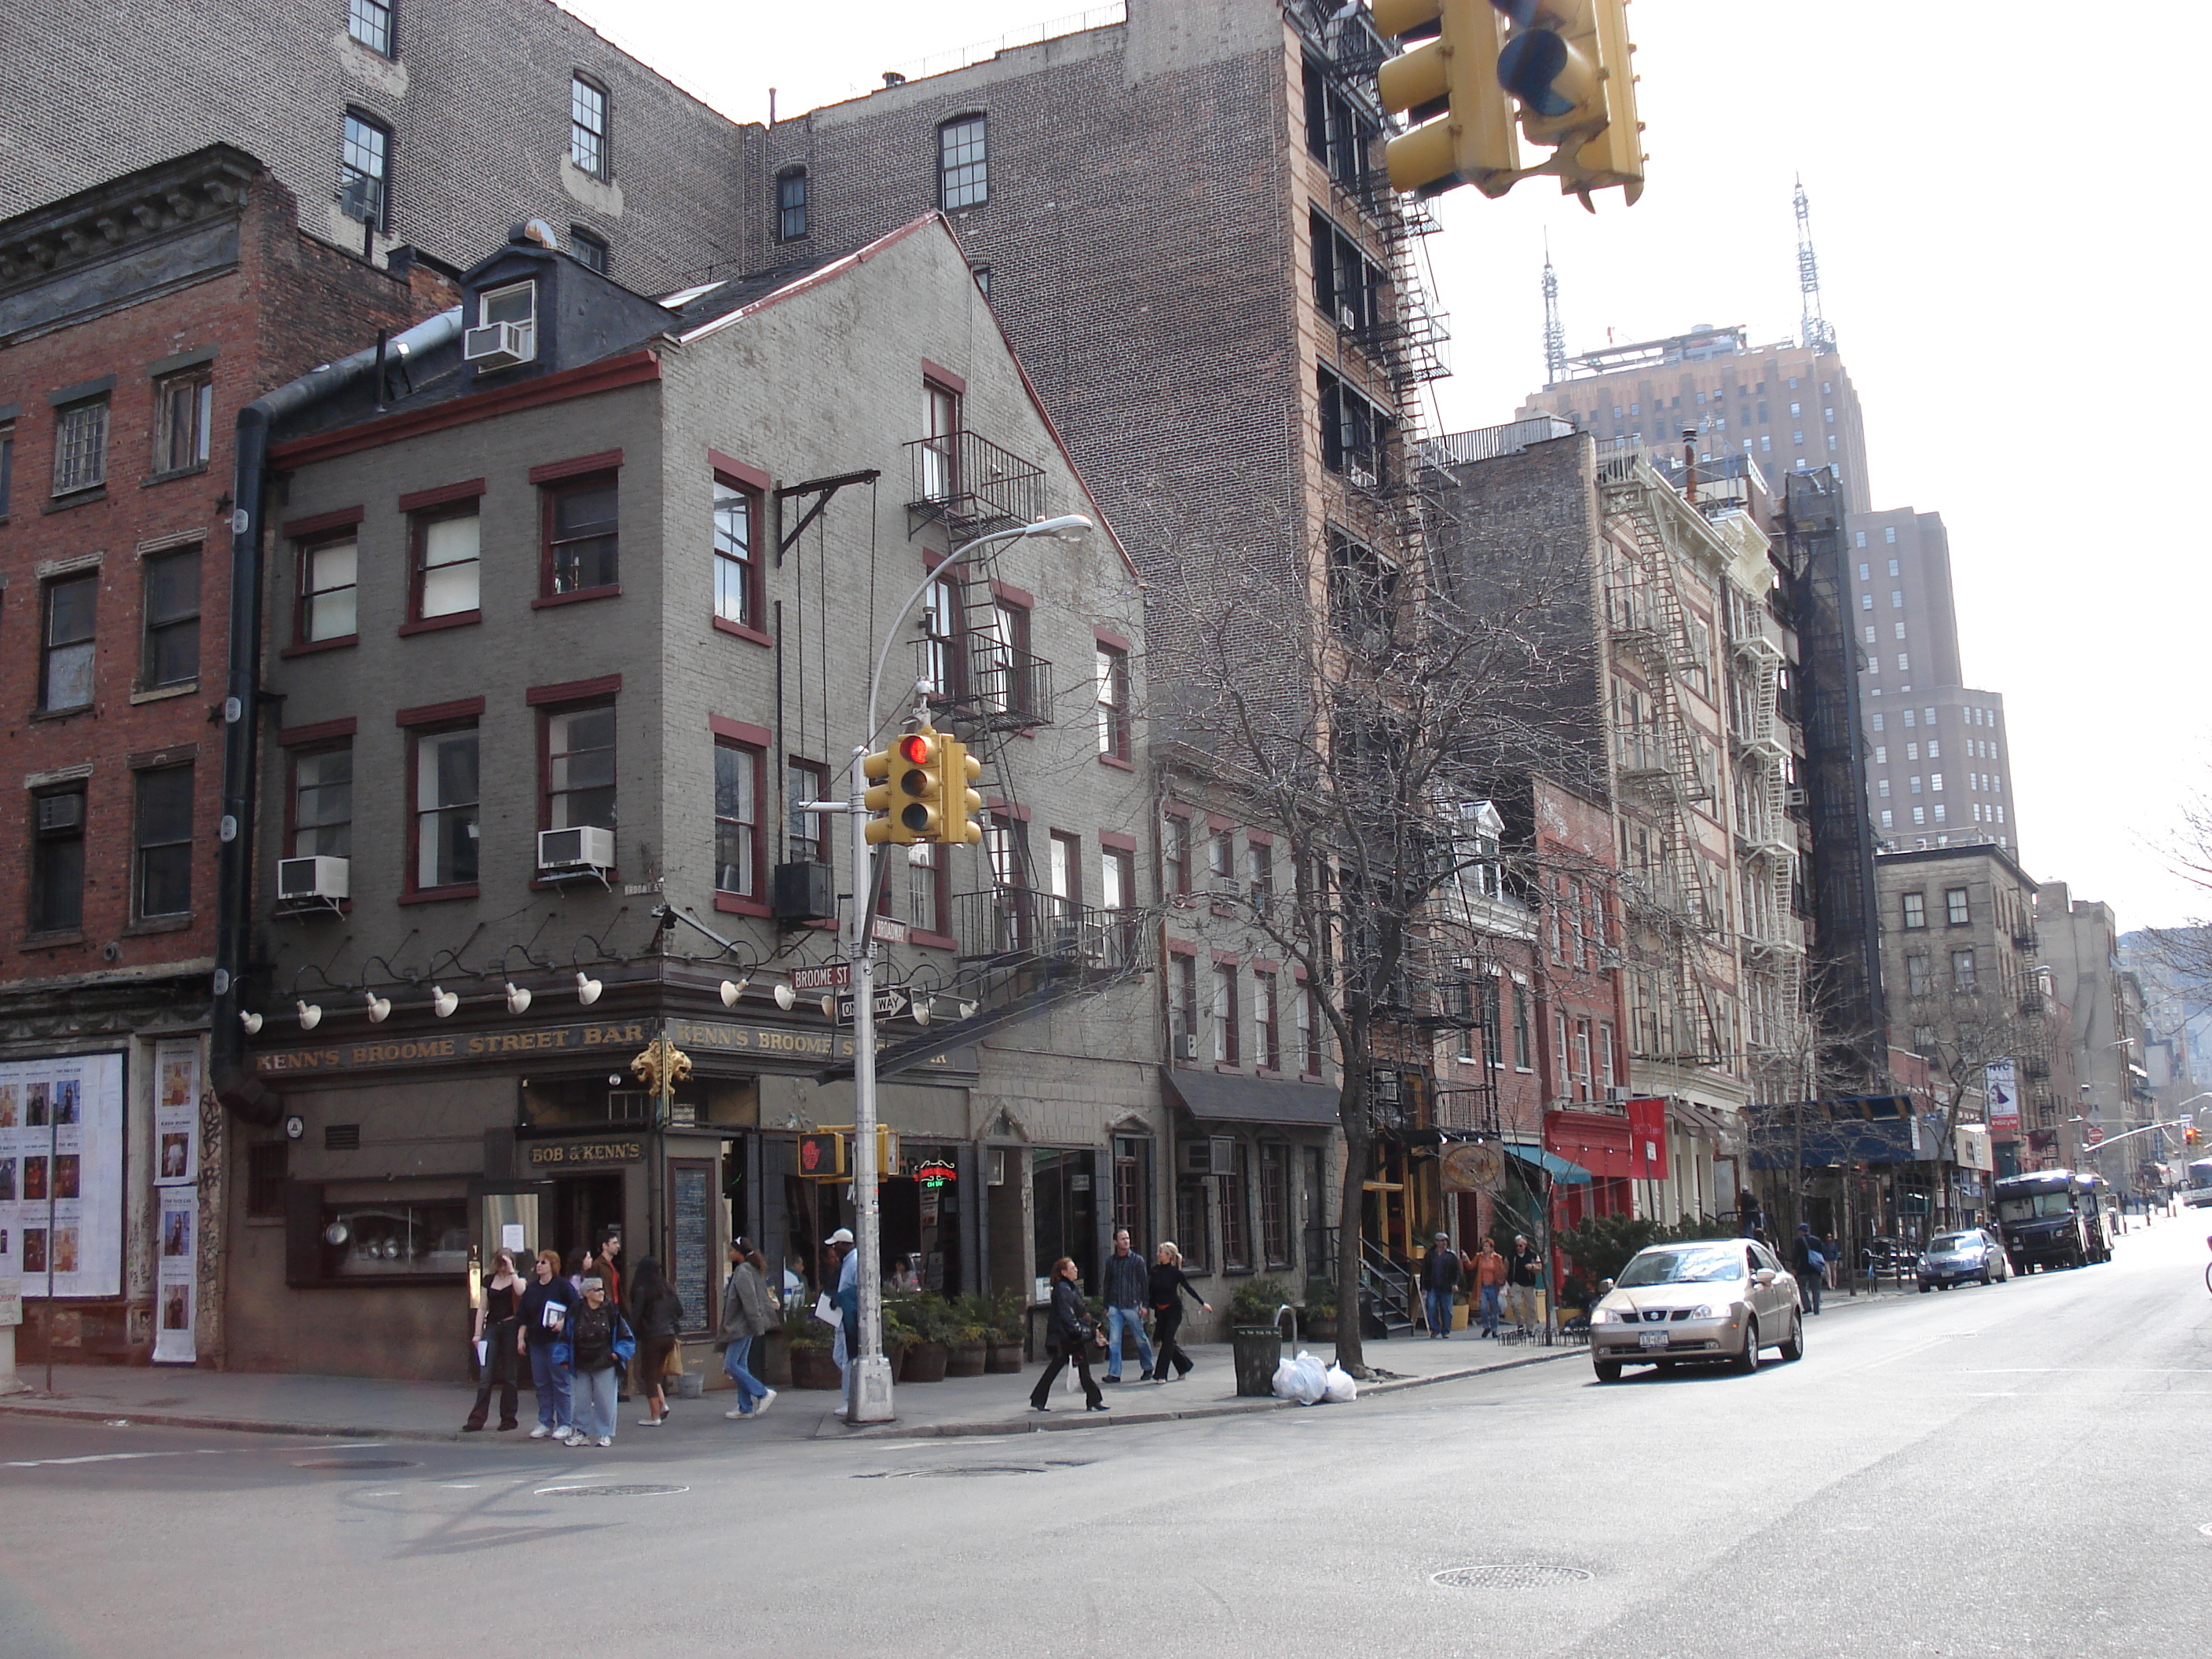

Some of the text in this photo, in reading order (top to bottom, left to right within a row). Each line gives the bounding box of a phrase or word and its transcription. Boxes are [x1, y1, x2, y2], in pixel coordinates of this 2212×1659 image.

[877, 919, 905, 942] BROADWAY
[795, 966, 848, 987] BROOME ST
[844, 997, 899, 1015] ON WAY
[255, 1024, 643, 1071] KENN'S BROOME STREET BAR
[676, 1024, 749, 1047] KENN'S
[758, 1031, 833, 1054] BROOME
[531, 1142, 641, 1163] BOB & KENN'S
